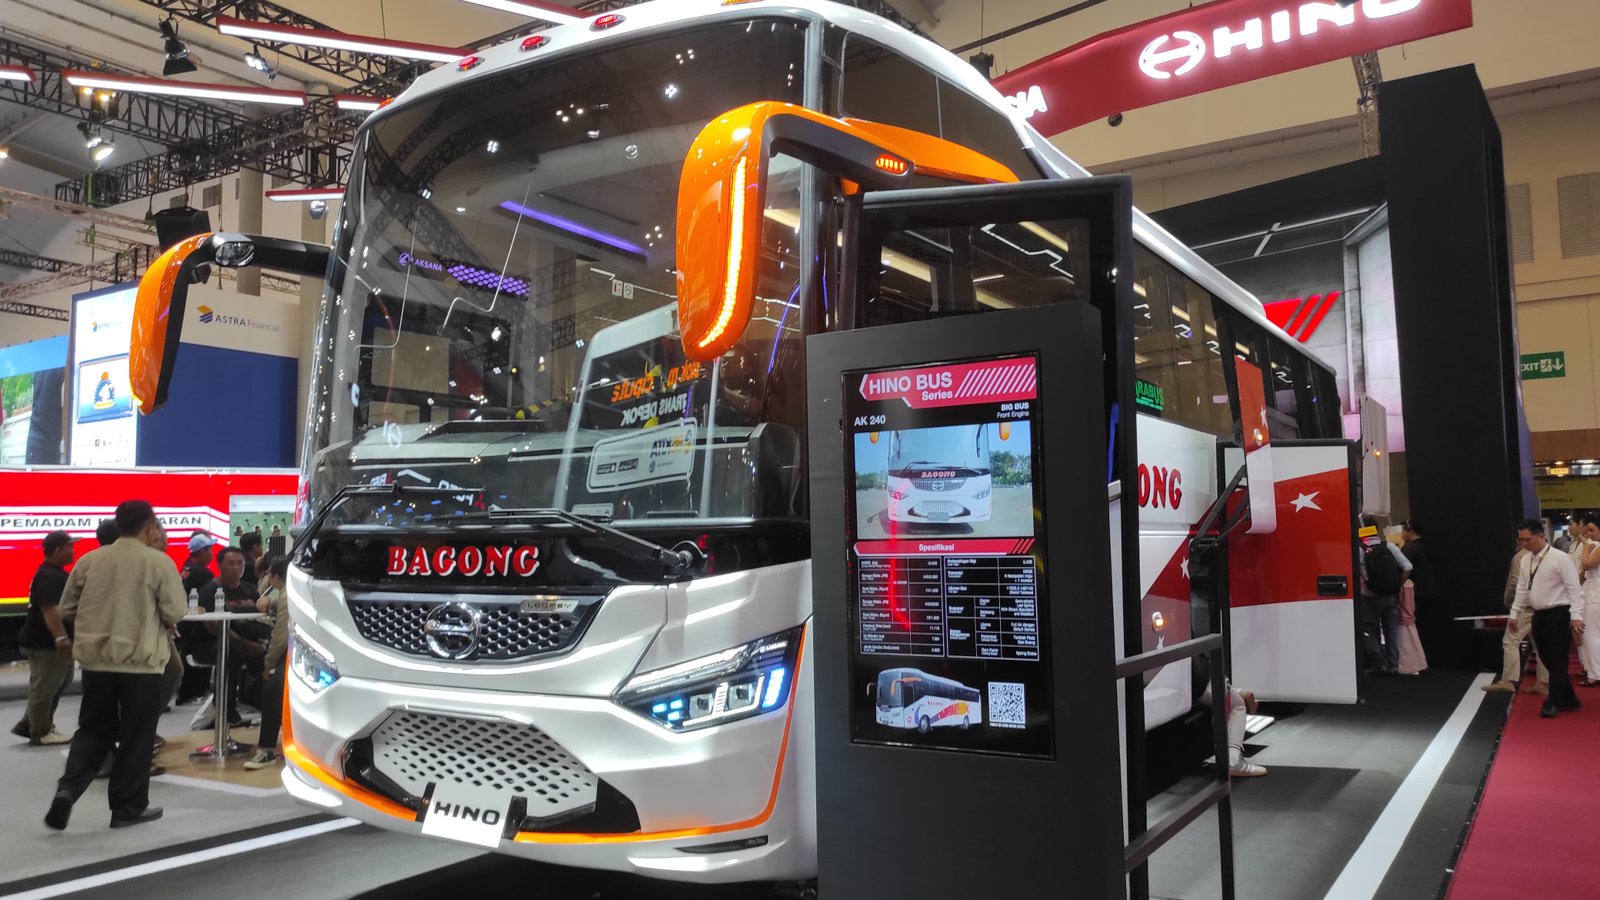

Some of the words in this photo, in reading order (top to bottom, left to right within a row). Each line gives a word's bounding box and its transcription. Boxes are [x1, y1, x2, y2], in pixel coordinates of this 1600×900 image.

[215, 315, 246, 326] ASTRA
[246, 319, 280, 332] Financial
[869, 376, 911, 395] HINO
[916, 371, 953, 390] BUS
[921, 389, 953, 401] Series
[1001, 403, 1013, 411] BIG
[1014, 402, 1029, 411] BUS
[854, 416, 868, 426] AK
[869, 415, 886, 425] 240
[997, 411, 1011, 419] Front
[1011, 410, 1030, 419] Engine
[1138, 463, 1182, 510] ONG
[0, 518, 91, 527] PEMADAM
[386, 545, 540, 577] BAGONG
[433, 801, 501, 826] HINO
